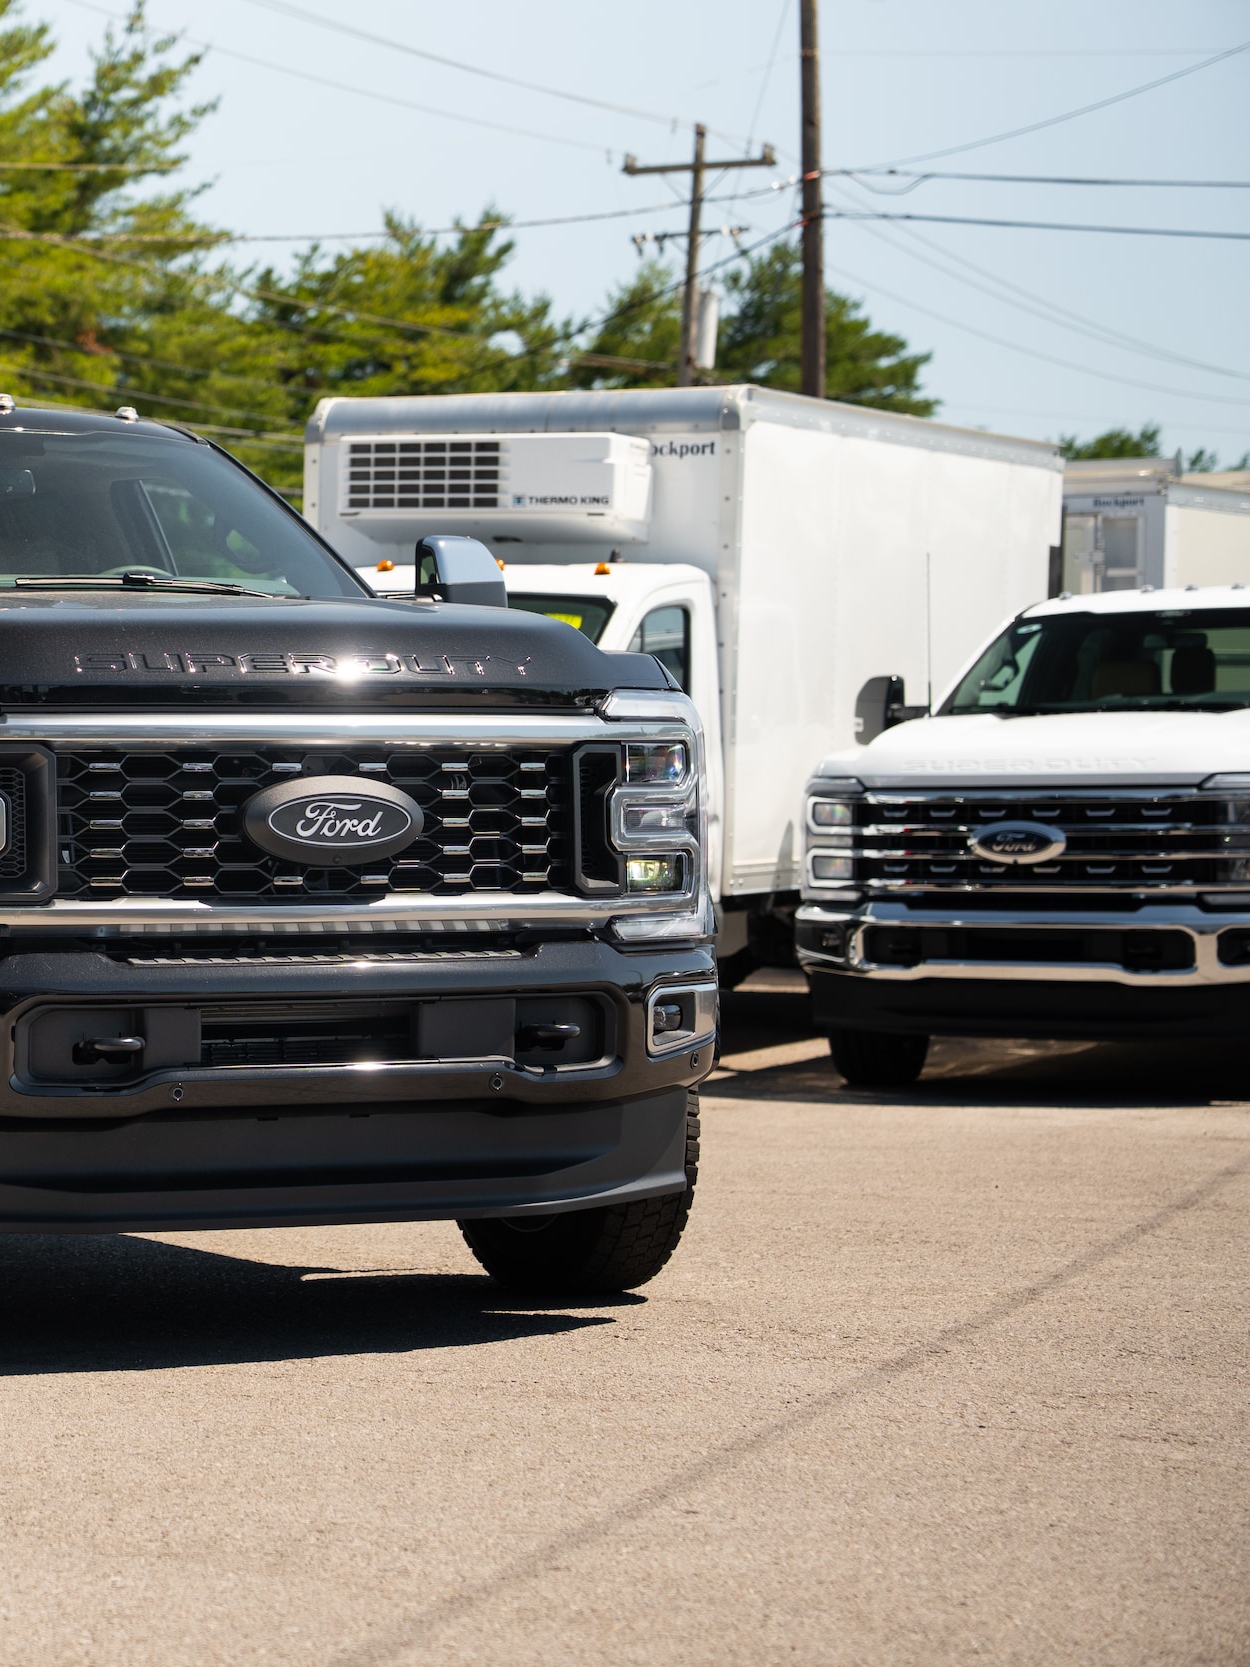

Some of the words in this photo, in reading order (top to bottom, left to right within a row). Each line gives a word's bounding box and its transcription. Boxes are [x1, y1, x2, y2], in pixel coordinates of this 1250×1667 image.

[650, 441, 715, 460] ockport
[528, 495, 578, 505] THERMO
[580, 495, 610, 505] KING
[74, 652, 338, 676] SUPER
[349, 652, 532, 676] DUTY
[296, 801, 384, 838] Ford
[992, 833, 1037, 852] Ford
